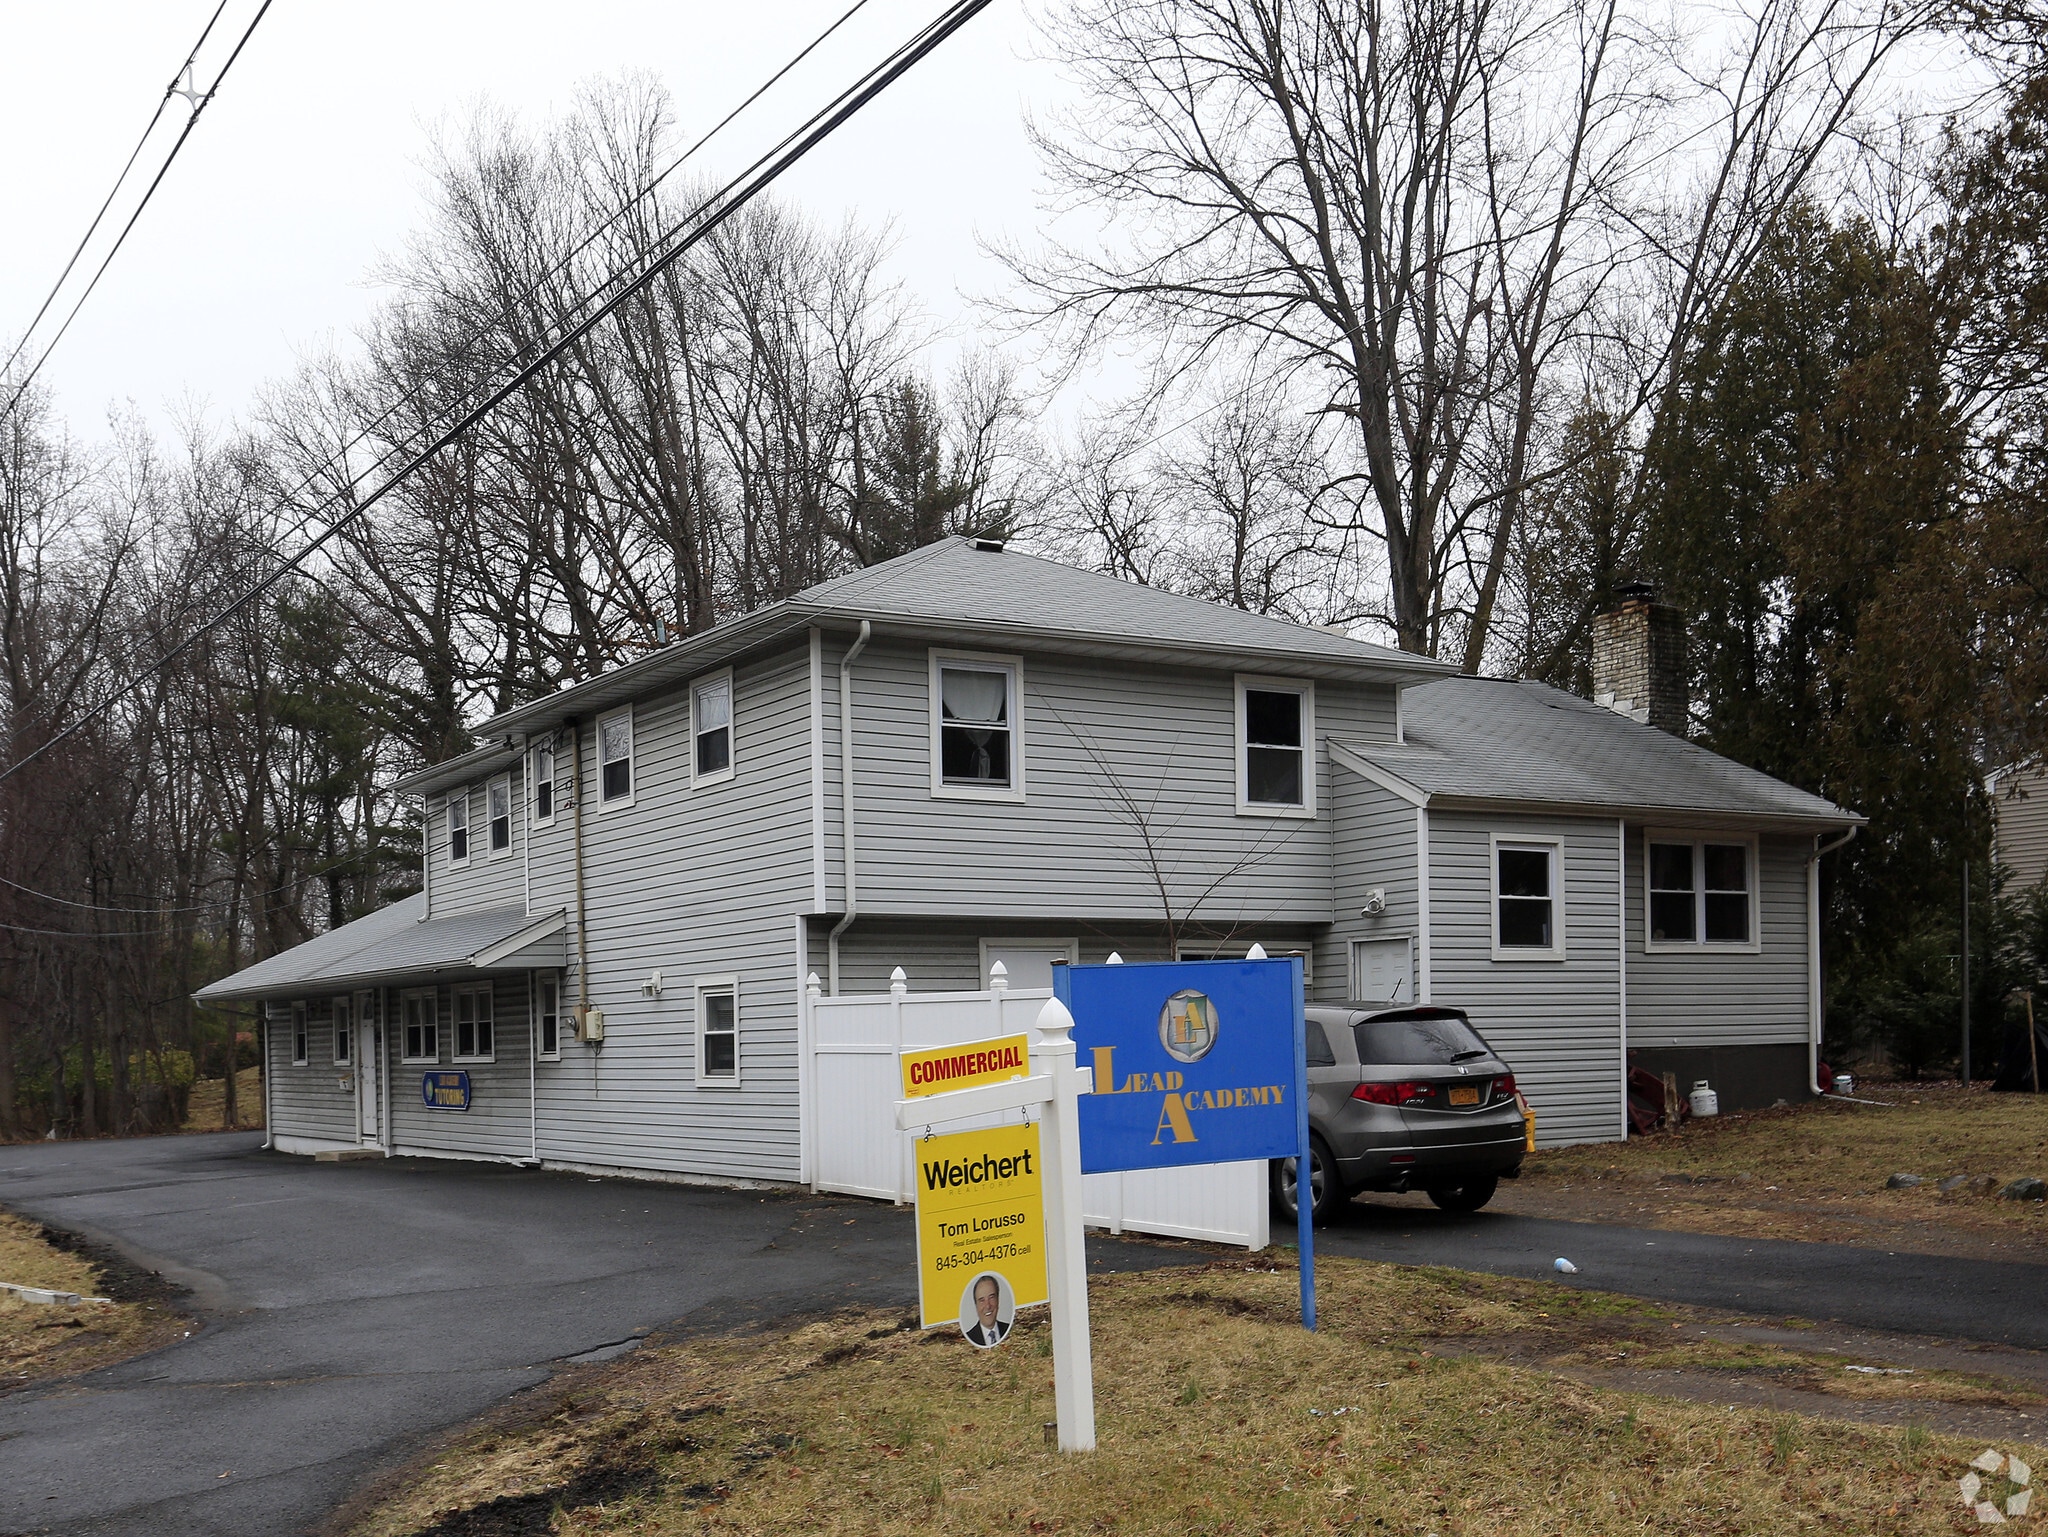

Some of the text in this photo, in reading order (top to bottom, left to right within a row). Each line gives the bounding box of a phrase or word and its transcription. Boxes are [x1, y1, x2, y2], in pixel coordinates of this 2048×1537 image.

[910, 1046, 1023, 1085] COMMERCIAL
[1089, 1046, 1184, 1096] LEAD
[1151, 1085, 1286, 1145] ACADEMY
[923, 1149, 1033, 1190] Weichert
[938, 1213, 1025, 1238] Tom Lorusso
[966, 1238, 981, 1246] Estate
[982, 1232, 1013, 1243] Salesperson
[936, 1243, 1031, 1271] 845-304-4376 cell
